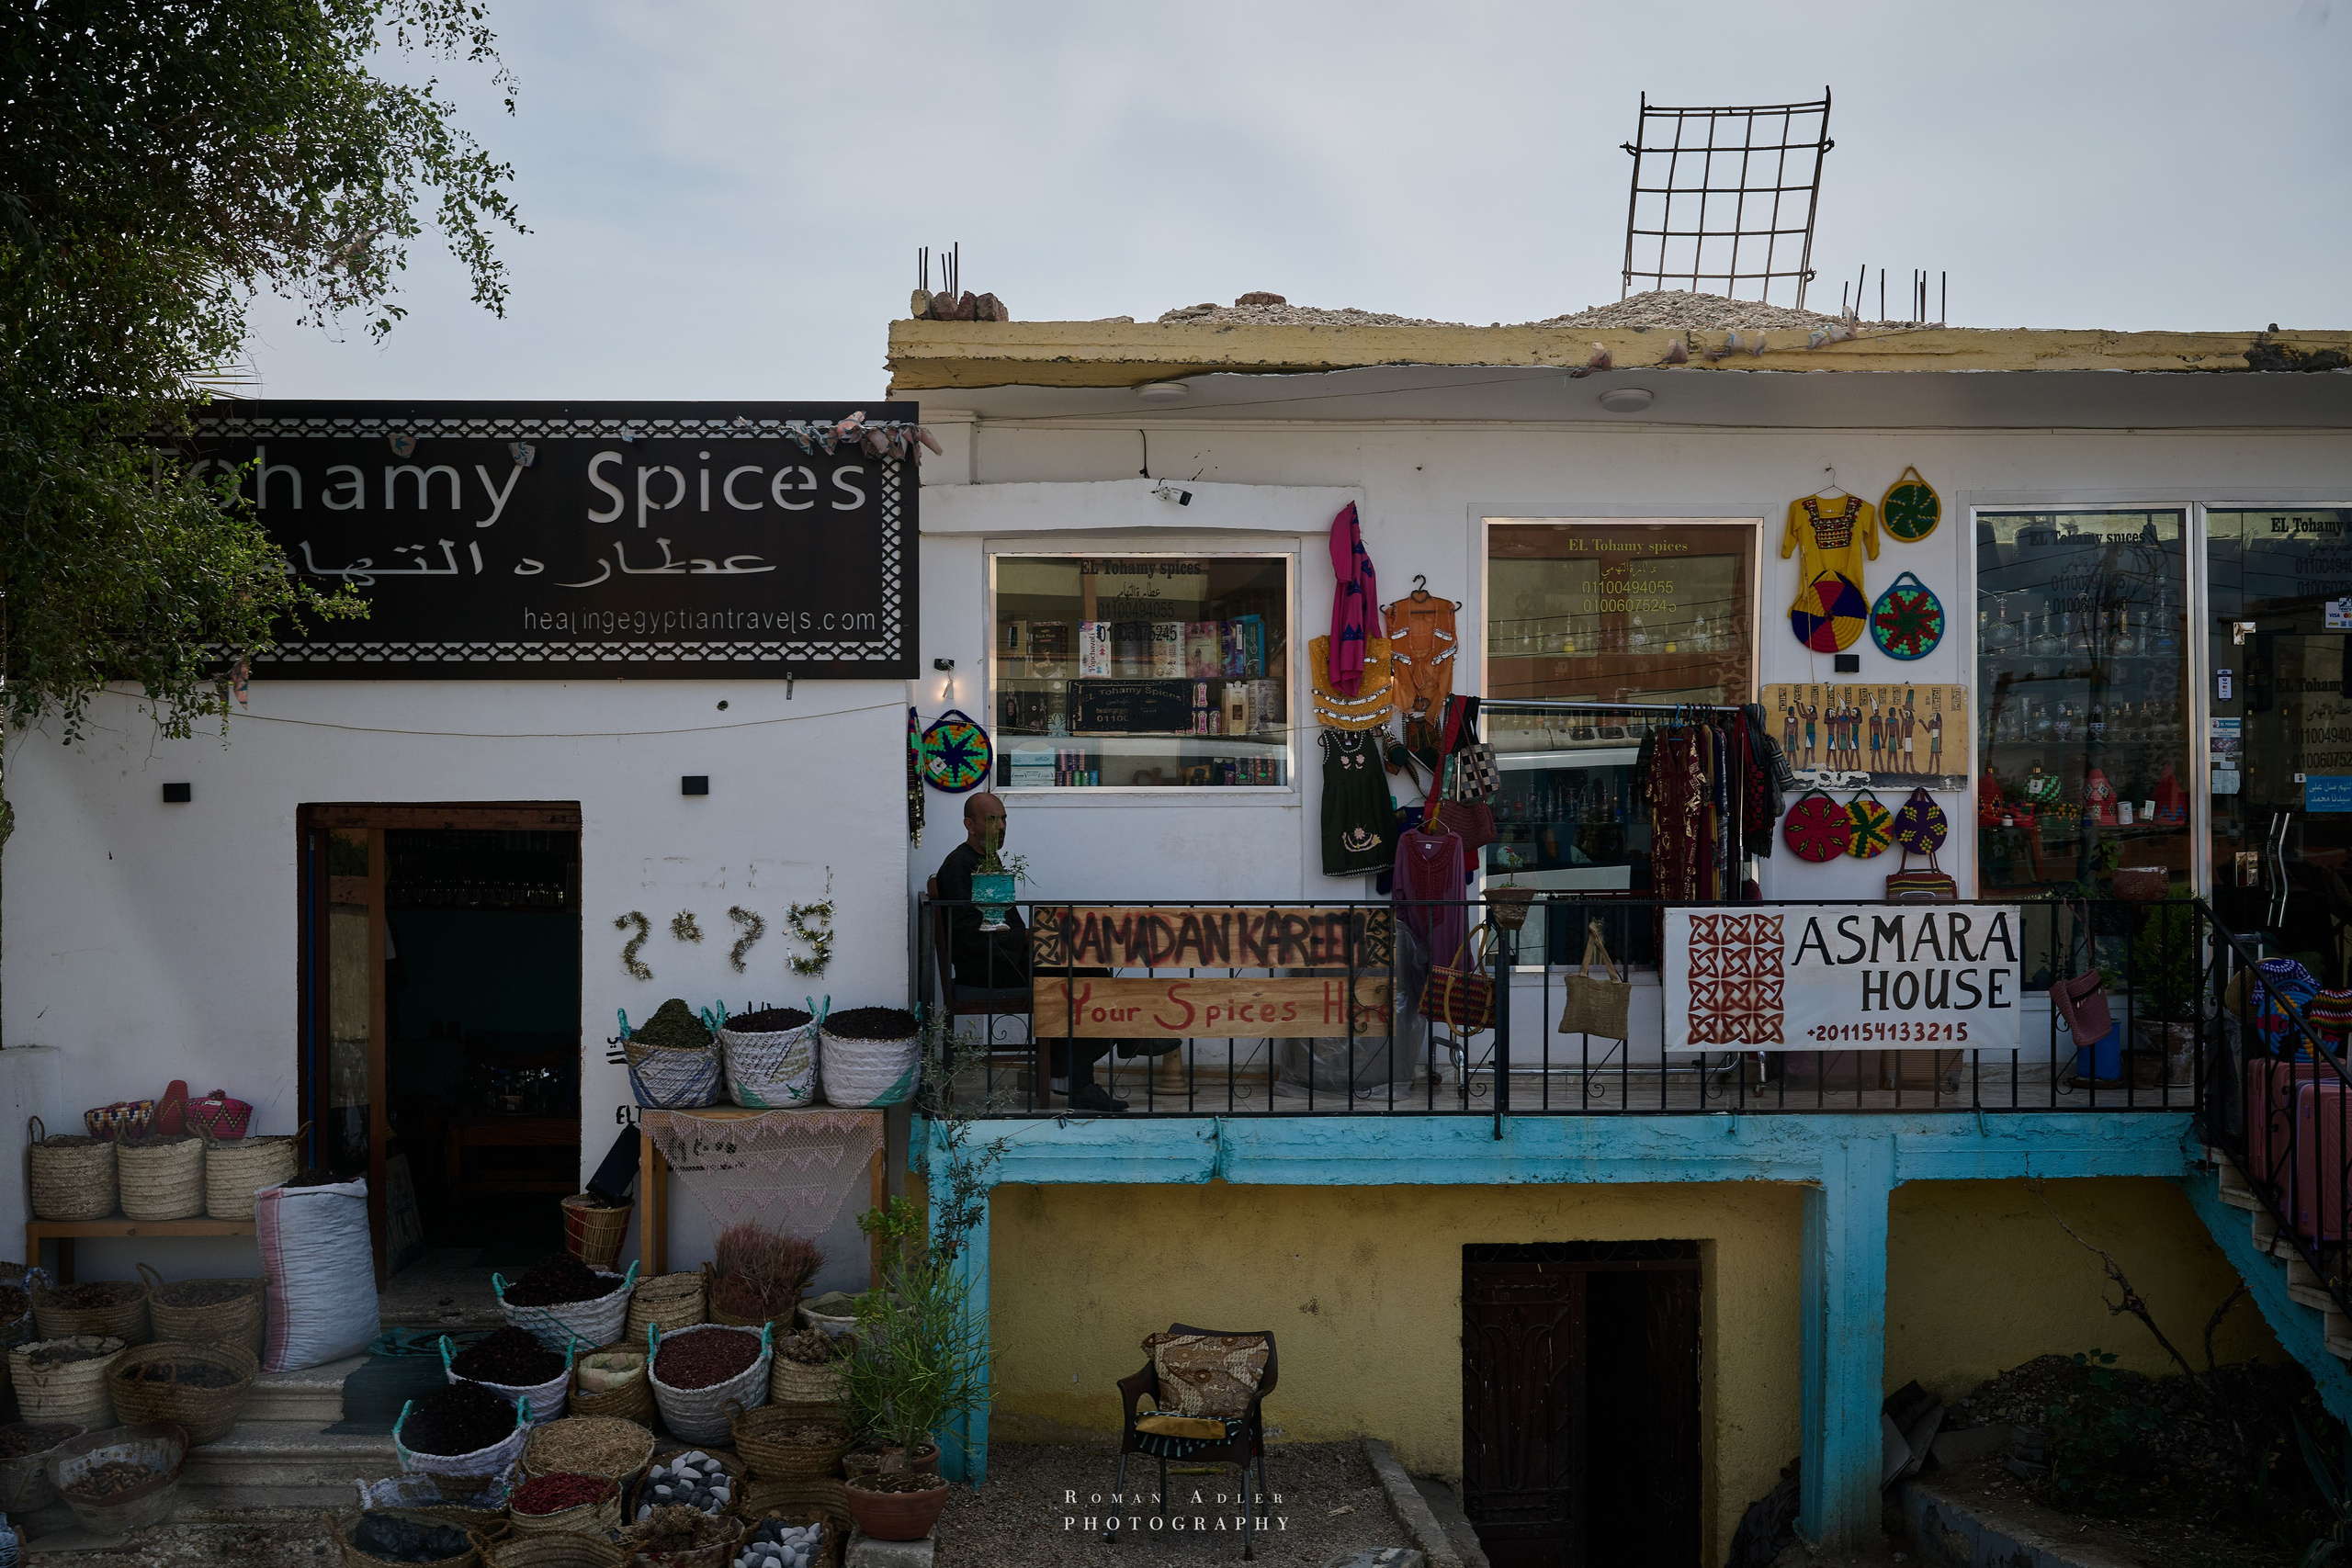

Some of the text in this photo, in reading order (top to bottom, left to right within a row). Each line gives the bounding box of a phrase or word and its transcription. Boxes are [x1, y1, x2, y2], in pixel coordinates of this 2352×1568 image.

[586, 450, 867, 529] Spices
[2271, 517, 2290, 533] EL
[2292, 517, 2344, 536] Tohamy
[1568, 538, 1689, 555] EL Tohamy spices
[2052, 530, 2103, 548] Tohamy
[1080, 559, 1202, 579] EL Tohamy spices
[1582, 581, 1674, 594] 01100494055
[524, 606, 876, 635] healingegyptiantravels.com
[1098, 602, 1175, 620] 01100494055
[1099, 686, 1142, 699] Tohamy
[1145, 686, 1182, 702] Spices
[2291, 727, 2352, 745] 011004940
[1057, 911, 1232, 968] RAMADAN
[1792, 911, 2018, 966] ASMARA
[1861, 968, 2012, 1011] HOUSE
[1061, 982, 1141, 1026] Your
[1153, 983, 1298, 1031] Spices
[1806, 1021, 1969, 1042] +201154133215
